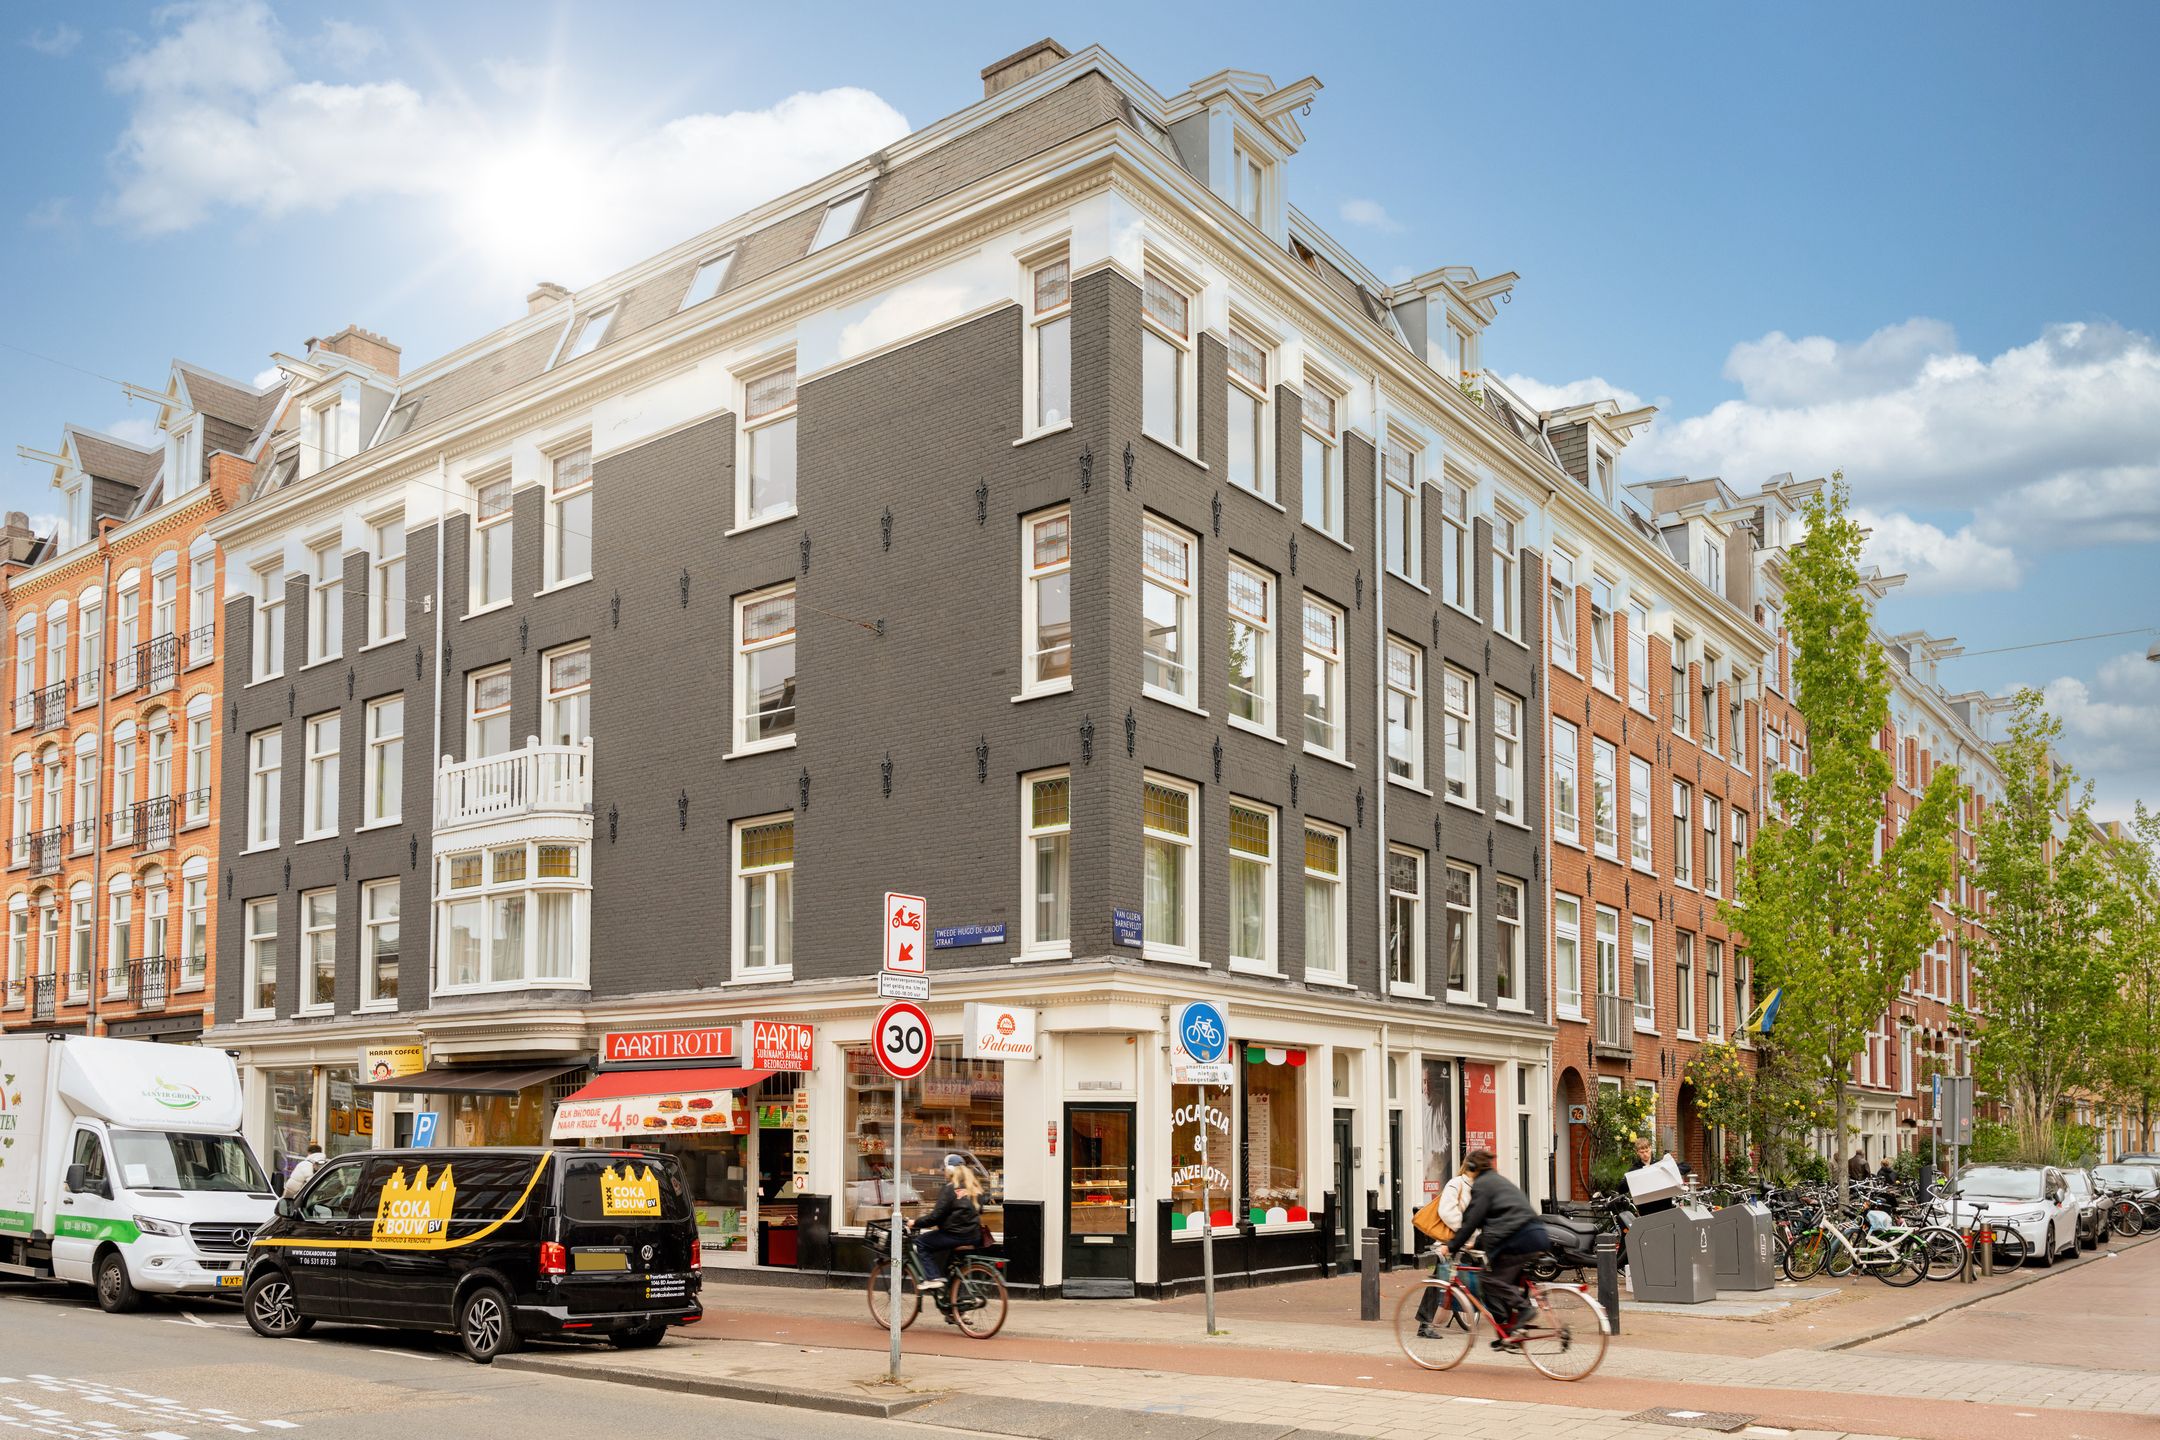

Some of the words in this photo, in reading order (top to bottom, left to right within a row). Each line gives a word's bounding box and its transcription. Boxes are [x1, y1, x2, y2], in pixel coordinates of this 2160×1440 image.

[1116, 910, 1125, 918] VAN
[1126, 911, 1141, 921] OLDEN
[1115, 919, 1142, 930] BARNEVELDT
[936, 928, 957, 938] TWEEDE
[958, 927, 974, 936] HUGO
[975, 926, 983, 934] DE
[984, 925, 1003, 934] GROOT
[1121, 929, 1136, 938] STRAAT
[935, 938, 954, 946] STRAAT
[755, 1023, 801, 1050] AARTI
[886, 1025, 924, 1055] 30
[614, 1034, 668, 1057] AARTI
[672, 1032, 723, 1055] ROTI
[978, 1033, 1033, 1054] Palesano
[394, 1048, 420, 1056] COFFEE
[756, 1048, 785, 1061] SURINAAMS
[785, 1050, 804, 1061] AFHAAL
[763, 1058, 802, 1070] BEZORGSERVICE
[559, 1110, 572, 1119] ELK
[573, 1107, 602, 1118] BROODJE
[1571, 1109, 1583, 1120] 76
[416, 1116, 432, 1141] P
[557, 1120, 575, 1130] NAAR
[576, 1119, 598, 1129] KEUZE
[1170, 1164, 1230, 1191] ANZEOTTI
[613, 1186, 645, 1198] COKA
[391, 1200, 431, 1218] COKA
[614, 1199, 645, 1209] BOUW
[647, 1199, 656, 1207] BV
[385, 1219, 427, 1235] BOUW
[428, 1219, 442, 1233] BV
[291, 1249, 337, 1258] WWW.COKABOUW.COM
[303, 1257, 310, 1265] 06
[310, 1257, 320, 1265] 531
[320, 1257, 330, 1265] 873
[330, 1258, 337, 1266] 53
[650, 1291, 685, 1299] info@cokabouw.com
